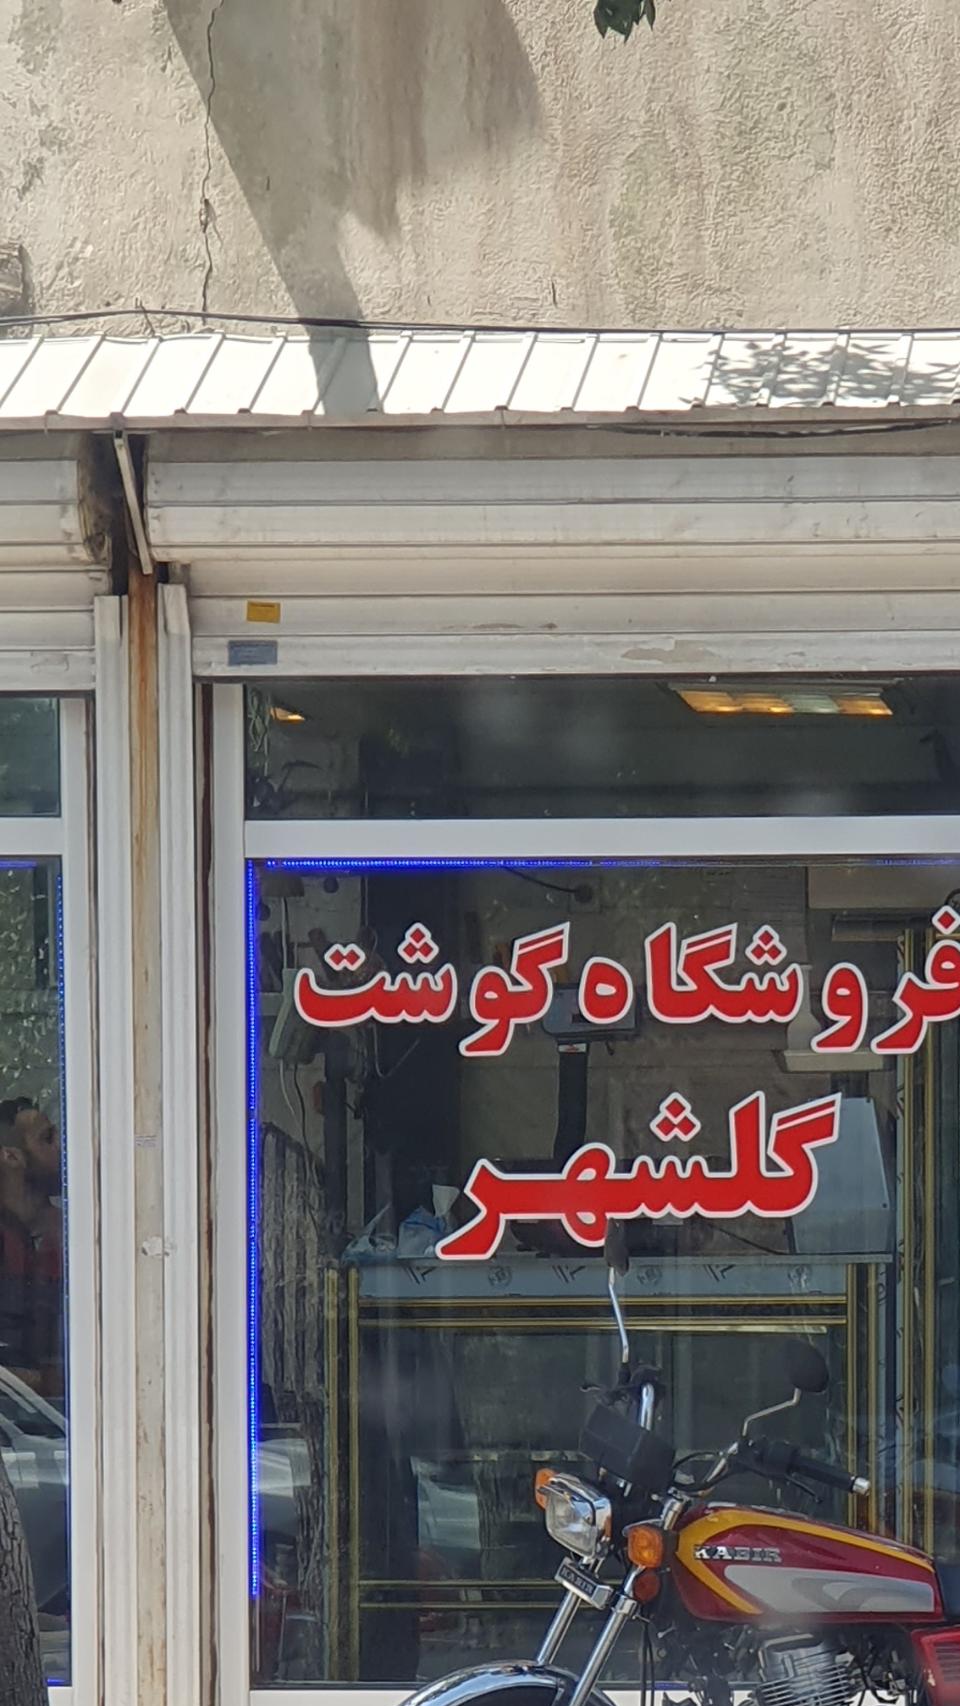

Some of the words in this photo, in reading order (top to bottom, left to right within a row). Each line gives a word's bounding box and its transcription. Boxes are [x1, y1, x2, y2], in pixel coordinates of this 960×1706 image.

[295, 922, 570, 1057] گوشت
[436, 1090, 841, 1261] گلشهر
[695, 1546, 782, 1562] KABIR
